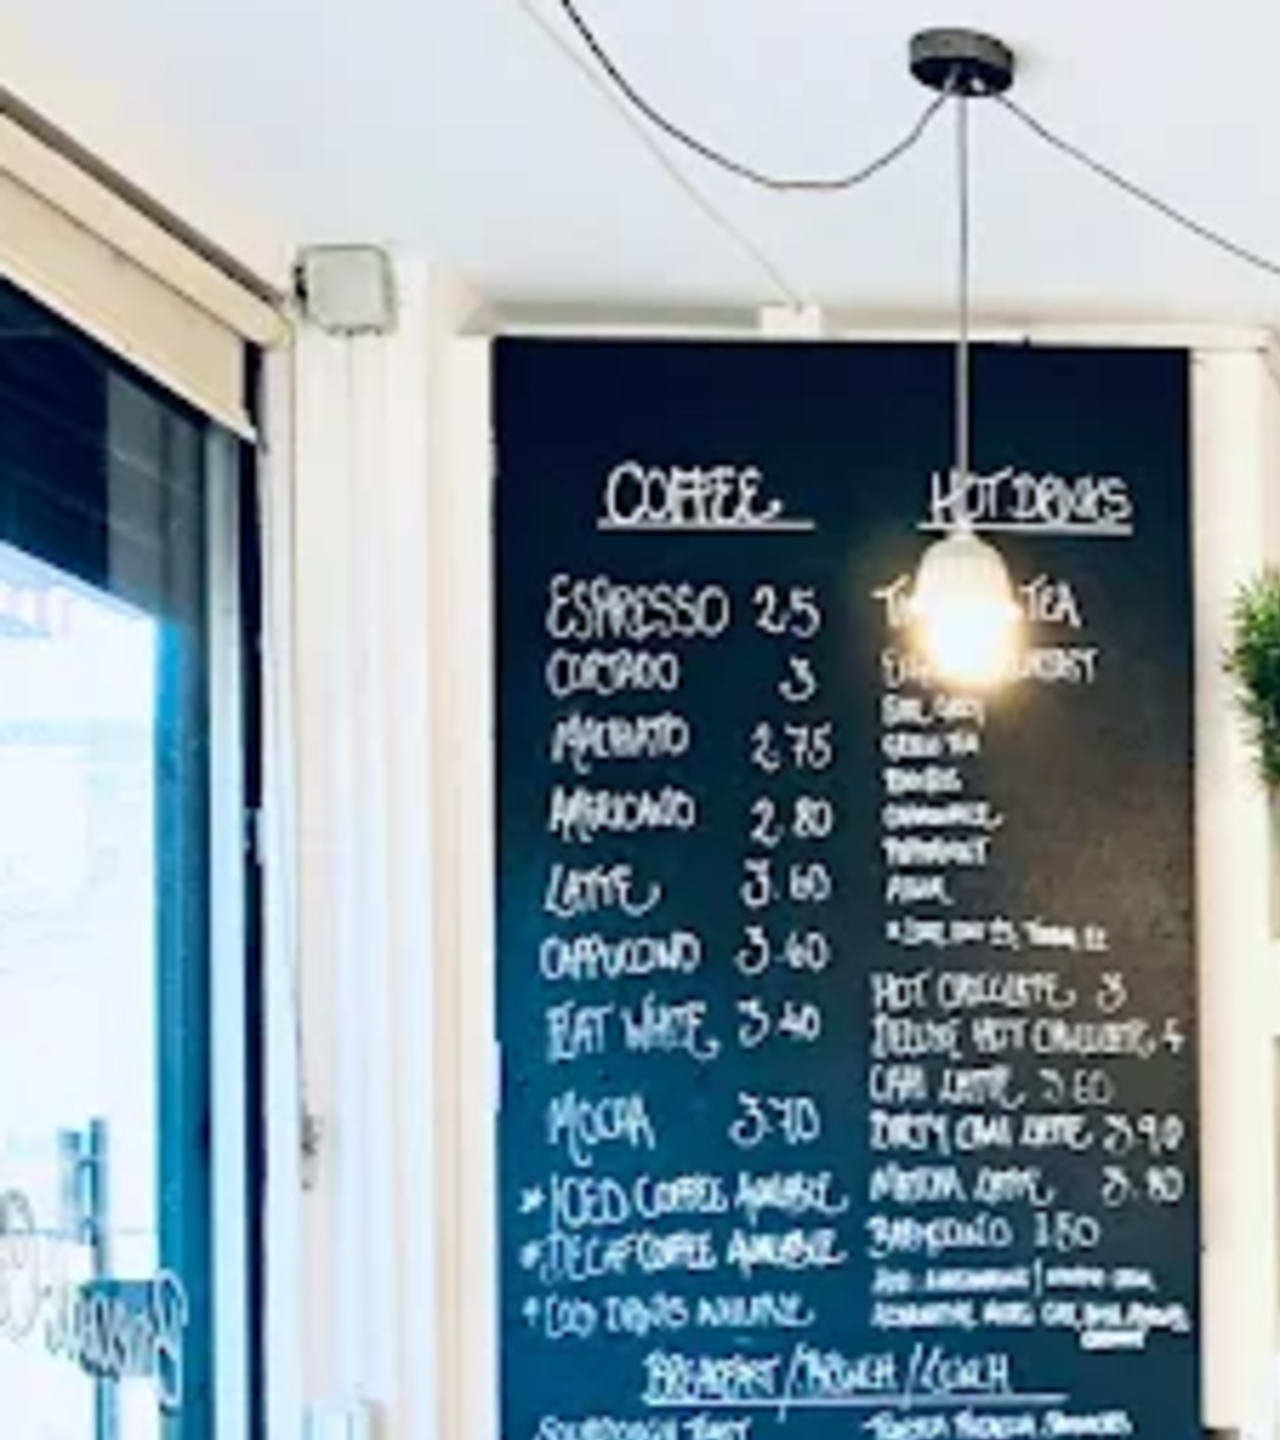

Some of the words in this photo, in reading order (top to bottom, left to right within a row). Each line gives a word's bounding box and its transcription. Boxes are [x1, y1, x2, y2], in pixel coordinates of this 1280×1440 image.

[604, 460, 783, 523] COFFEE
[545, 572, 730, 643] ESPRESSO
[1023, 577, 1082, 628] TEA
[780, 658, 815, 703] 3
[871, 970, 929, 1006] HOT
[1097, 972, 1127, 1013] 3
